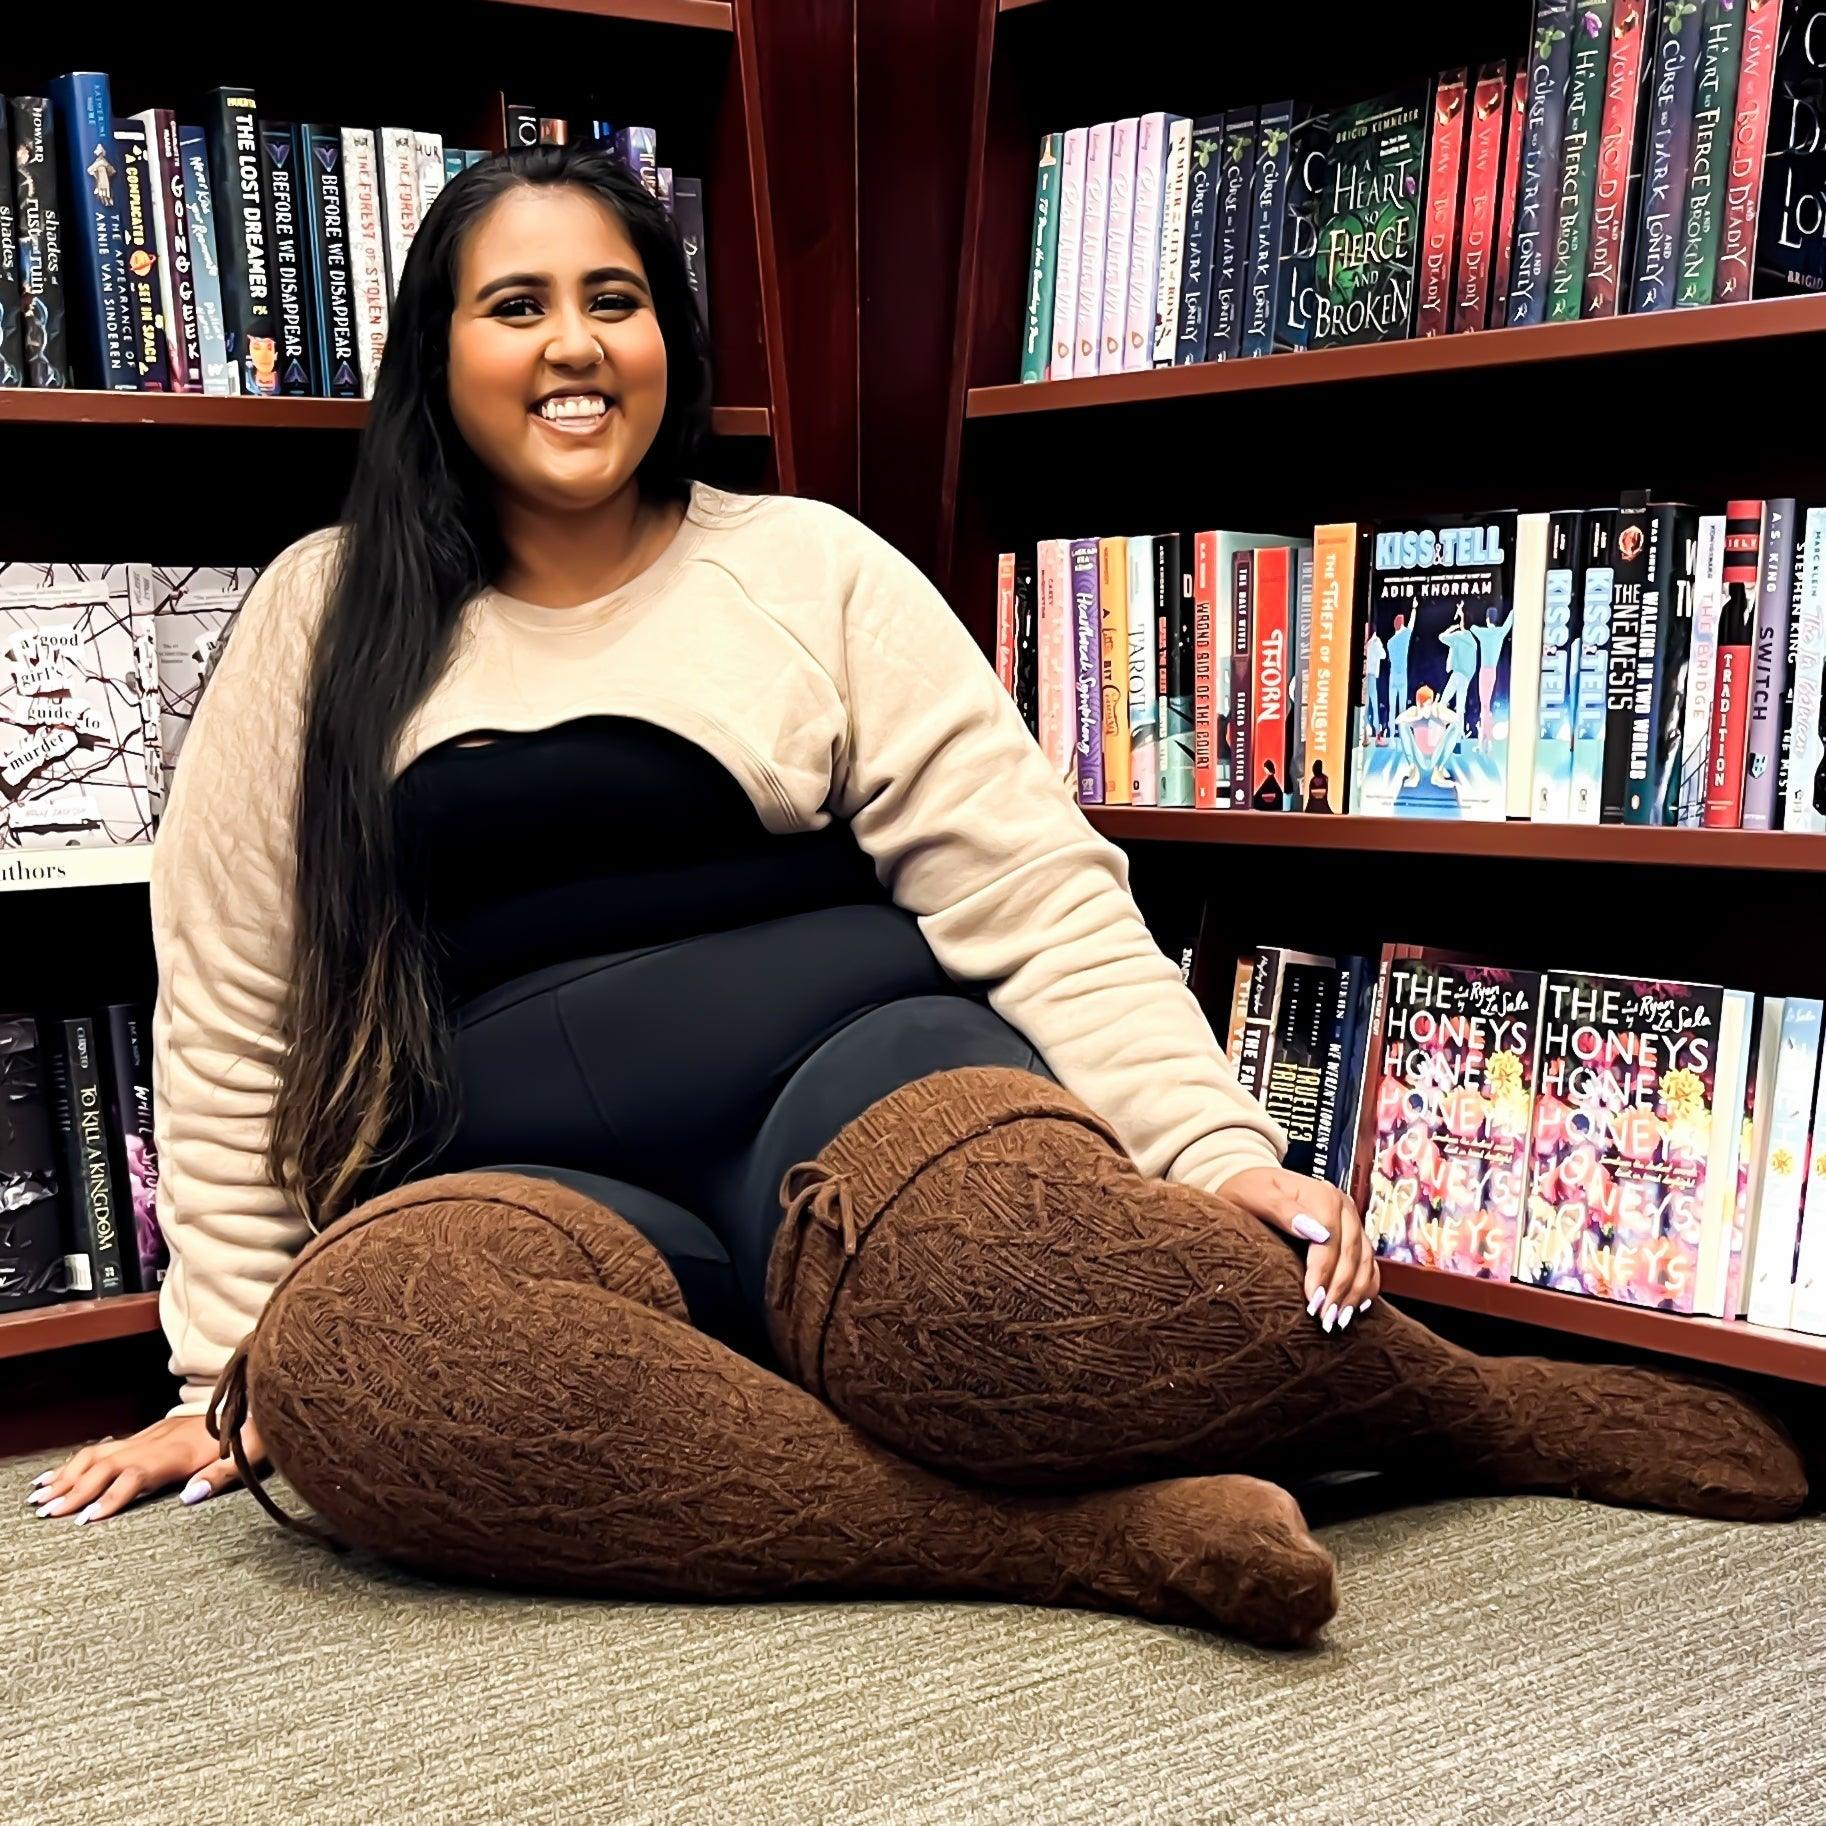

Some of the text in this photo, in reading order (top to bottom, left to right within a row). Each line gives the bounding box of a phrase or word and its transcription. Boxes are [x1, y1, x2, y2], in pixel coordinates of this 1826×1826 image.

[32, 107, 44, 163] HOWARD
[235, 113, 256, 151] THE
[1683, 23, 1733, 278] HEART FIERCE BROKEN
[1720, 16, 1768, 267] VOW BOLD DEADLY
[189, 157, 209, 190] Never
[238, 155, 260, 204] LOST
[357, 155, 369, 178] THE
[398, 155, 410, 177] THE
[1173, 137, 1186, 206] SUMMER
[1332, 158, 1414, 214] HEART
[1511, 64, 1554, 301] CURSE DARK LONELY
[1553, 50, 1599, 294] HEART FIERCE BROKEN
[1588, 44, 1631, 284] VOW DEADLY
[1639, 40, 1683, 287] CURSE DARK LONELY
[0, 206, 15, 268] shades
[357, 183, 376, 240] FOREST
[398, 183, 416, 239] FOREST
[1364, 210, 1379, 225] SO
[1702, 210, 1712, 233] AND
[27, 198, 47, 294] rust ruin
[45, 209, 61, 272] shades
[124, 153, 157, 363] A COMPLICATED SET IN SPACE
[171, 174, 200, 360] GOING GEEK
[243, 207, 268, 299] DREAMER
[271, 171, 302, 358] BEFORE WE DISAPPEAR
[321, 174, 352, 360] BEFORE WE DISAPPEAR
[1170, 228, 1180, 265] CITY
[1180, 170, 1208, 343] CURSE LONELY
[1213, 165, 1242, 340] CURSE LONELY
[1247, 160, 1277, 337] CURSE LONELY
[1328, 216, 1410, 291] FIERCE
[1533, 252, 1542, 276] AND
[1570, 229, 1579, 251] AND
[1663, 235, 1673, 259] AND
[95, 212, 122, 369] ANNIE VAN SINDEREN
[111, 214, 135, 368] THE APPEARANCE OF
[365, 267, 382, 325] STOLEN
[1351, 270, 1379, 288] AND
[1422, 251, 1444, 312] DEADLY
[1460, 250, 1482, 311] DEADLY
[1165, 286, 1176, 337] ROSES
[1313, 278, 1411, 339] BROKEN
[1324, 553, 1337, 579] THE
[1766, 512, 1782, 593] A.S. KING
[1811, 531, 1821, 597] MARC KLEIN
[1237, 568, 1248, 650] THE HALF WIVES
[1319, 580, 1339, 641] THEFT
[1380, 581, 1492, 599] ADIB KHORRAM
[1613, 583, 1642, 604] THE
[20, 633, 78, 650] a good
[1076, 592, 1095, 671] Heartbreak
[1102, 608, 1112, 681] A BIT
[1196, 602, 1210, 648] WRONG
[1801, 605, 1825, 645] The
[21, 665, 63, 686] girl's
[1127, 624, 1146, 713] TAROT
[1196, 652, 1210, 680] SIDE
[1256, 628, 1283, 724] THORN
[1319, 645, 1331, 663] OF
[1607, 605, 1640, 710] NEMESIS
[1692, 593, 1714, 720] THE BRIDGE
[1752, 627, 1774, 720] SWITCH
[1196, 685, 1210, 701] OF
[1311, 668, 1331, 753] SUNLIGHT
[1629, 591, 1660, 780] WALKING IN TWO WORLDS
[28, 706, 100, 730] guide to
[1076, 674, 1097, 757] Symphony
[1196, 704, 1210, 729] THE
[1714, 653, 1733, 787] TRADITION
[1793, 680, 1816, 757] Between
[9, 732, 65, 771] murder
[1196, 731, 1210, 770] COURT
[1335, 971, 1350, 1019] KUEHN
[1392, 971, 1454, 1009] THE
[1469, 981, 1500, 1007] Ryan
[1498, 990, 1530, 1018] Sala
[1549, 984, 1621, 1025] THE
[1638, 995, 1675, 1022] Ryan
[1243, 1029, 1261, 1060] THE
[1387, 1007, 1528, 1056] HONEYS
[1672, 1005, 1712, 1034] Sala
[1327, 1043, 1342, 1060] WE
[1545, 1022, 1710, 1074] HONEYS
[1315, 1107, 1334, 1152] LOOKING
[80, 1084, 115, 1251] TO KILL A KINGDOM
[1313, 1153, 1328, 1166] TO
